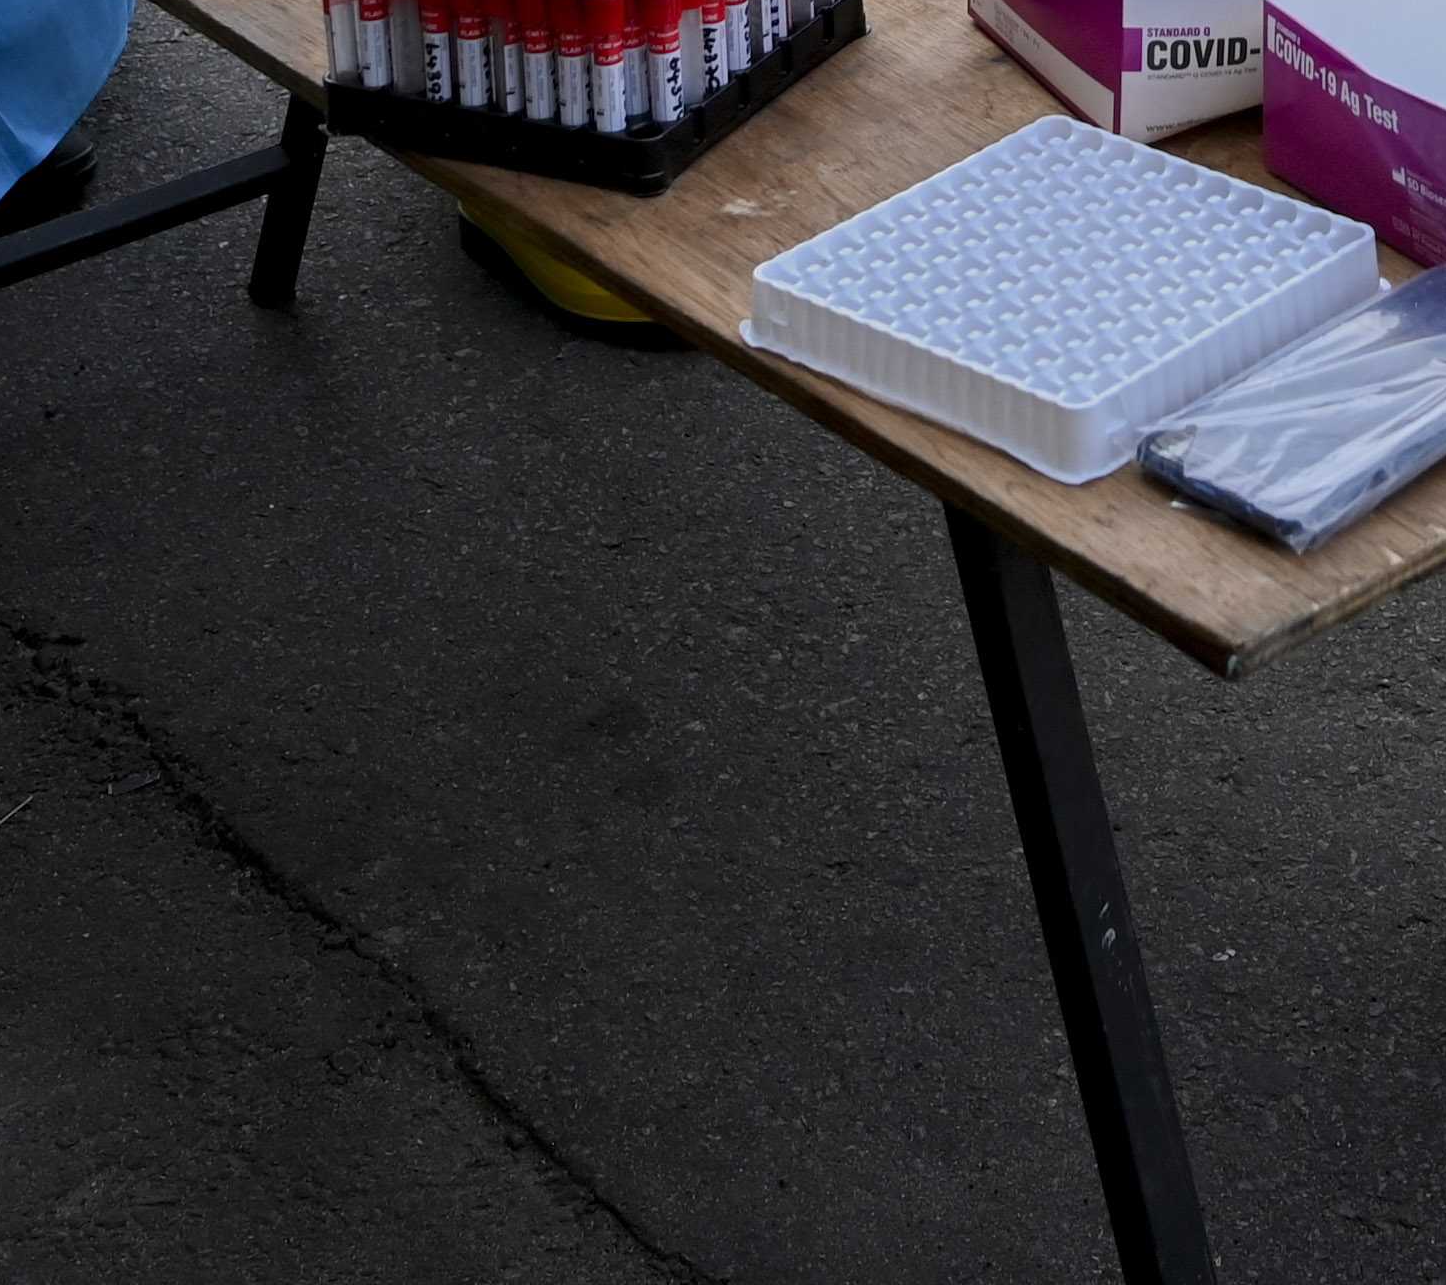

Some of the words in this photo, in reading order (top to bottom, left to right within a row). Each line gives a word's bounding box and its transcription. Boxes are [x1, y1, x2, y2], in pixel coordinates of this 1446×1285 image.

[1147, 27, 1200, 37] STANDARD
[1146, 37, 1260, 71] COVID-
[1275, 32, 1337, 97] COVID-19
[1340, 80, 1360, 117] Ag
[1364, 94, 1400, 133] Test
[1407, 177, 1419, 192] SD
